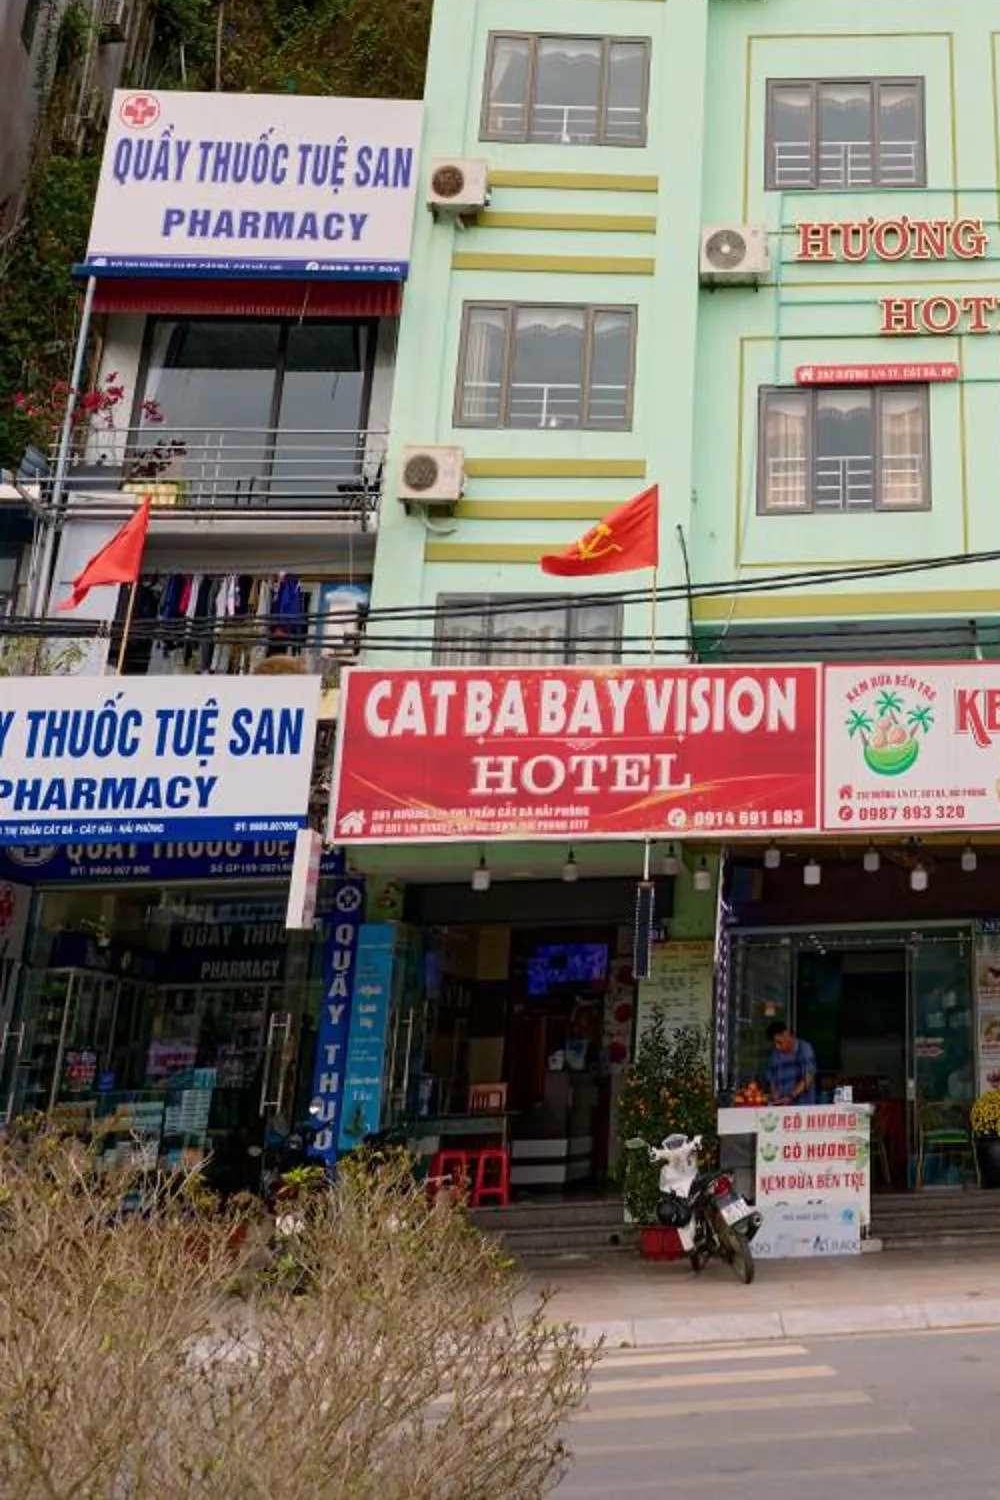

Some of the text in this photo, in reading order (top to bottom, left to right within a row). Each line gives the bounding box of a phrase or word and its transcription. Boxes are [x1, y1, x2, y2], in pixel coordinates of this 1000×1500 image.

[198, 127, 289, 185] THUỐC
[297, 135, 348, 195] TUỆ
[354, 146, 413, 188] SAN
[162, 208, 368, 241] PHARMACY
[795, 215, 987, 262] HƯƠNG
[25, 692, 142, 758] THUỐC
[155, 698, 219, 767] TUỆ
[228, 708, 304, 755] SAN
[364, 676, 798, 738] CAT BA BAY VISION
[470, 753, 692, 796] HOTEL
[859, 804, 965, 821] 0987 893 320
